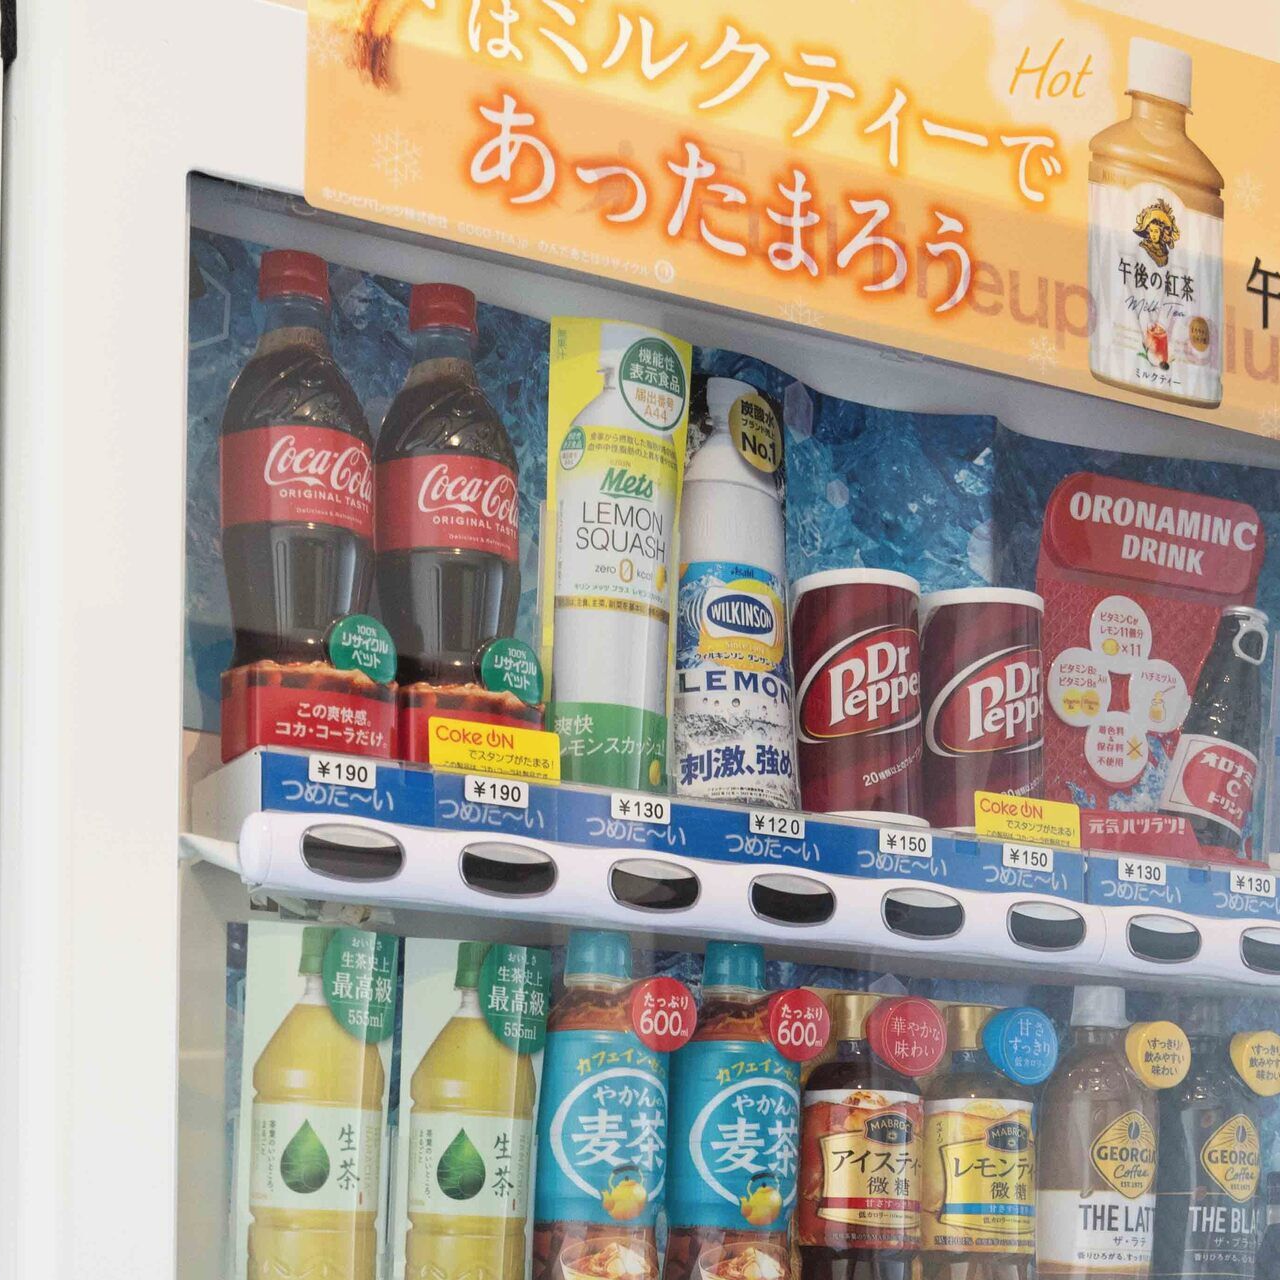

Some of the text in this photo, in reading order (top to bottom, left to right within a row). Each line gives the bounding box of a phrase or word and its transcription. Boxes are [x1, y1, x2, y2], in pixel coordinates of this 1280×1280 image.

[1009, 38, 1093, 100] Hot
[423, 0, 1061, 202] はミルクティーで
[470, 93, 972, 313] あったまろう
[1117, 259, 1195, 302] 午後の紅茶
[638, 348, 676, 374] 機能性
[630, 363, 680, 394] 表示食品
[1135, 367, 1181, 387] ミルクティー
[600, 467, 654, 500] Mets
[582, 501, 663, 536] LEMON
[575, 526, 666, 563] SQUASH
[1121, 534, 1205, 576] DRINK
[710, 602, 772, 629] WILKINSON
[341, 633, 388, 655] リサイクル
[352, 651, 381, 669] ペット
[866, 641, 910, 679] Dr
[503, 672, 531, 691] ペット
[678, 670, 792, 704] LEMON
[297, 702, 372, 727] この爽快感。
[554, 714, 593, 735] 爽快
[275, 721, 388, 749] コカ・コーラだけ。
[435, 724, 482, 747] Coke
[318, 760, 369, 784] ¥190
[473, 781, 522, 804] ¥190
[619, 799, 664, 820] ¥130
[980, 798, 1018, 817] Coke
[1208, 791, 1245, 819] ドリンク
[754, 815, 800, 835] ¥120
[1089, 817, 1186, 835] 元気ハツラツ!
[886, 834, 927, 853] ¥150
[1009, 848, 1048, 867] ¥150
[1124, 863, 1161, 881] ¥130
[1236, 877, 1271, 894] ¥130
[340, 951, 391, 974] 生茶史上
[496, 965, 543, 988] 生茶史上
[332, 972, 393, 1005] 最高級
[487, 984, 545, 1017] 最高級
[644, 993, 690, 1010] たっぷり
[348, 1009, 384, 1029] 555ml
[781, 1003, 823, 1021] たっぷり
[503, 1021, 537, 1041] 555ml
[890, 1017, 940, 1041] 華やかな
[1018, 1019, 1044, 1038] 甘さ
[894, 1040, 935, 1059] 味わい
[1009, 1037, 1051, 1058] すっきり
[1144, 1052, 1185, 1064] 飲みやすい
[1151, 1064, 1178, 1076] 味わい
[1255, 1070, 1280, 1080] 味わい
[870, 1118, 911, 1134] MABROC
[991, 1127, 1027, 1141] MABROC
[572, 1108, 667, 1171] 麦茶
[710, 1117, 798, 1177] 麦茶
[336, 1123, 360, 1190] 生茶
[491, 1132, 514, 1198] 生茶
[1096, 1145, 1156, 1164] GEORGIA
[1113, 1164, 1149, 1179] Coffee
[1224, 1168, 1255, 1182] Coffee
[867, 1176, 910, 1197] 微糖
[990, 1182, 1028, 1201] 微糖
